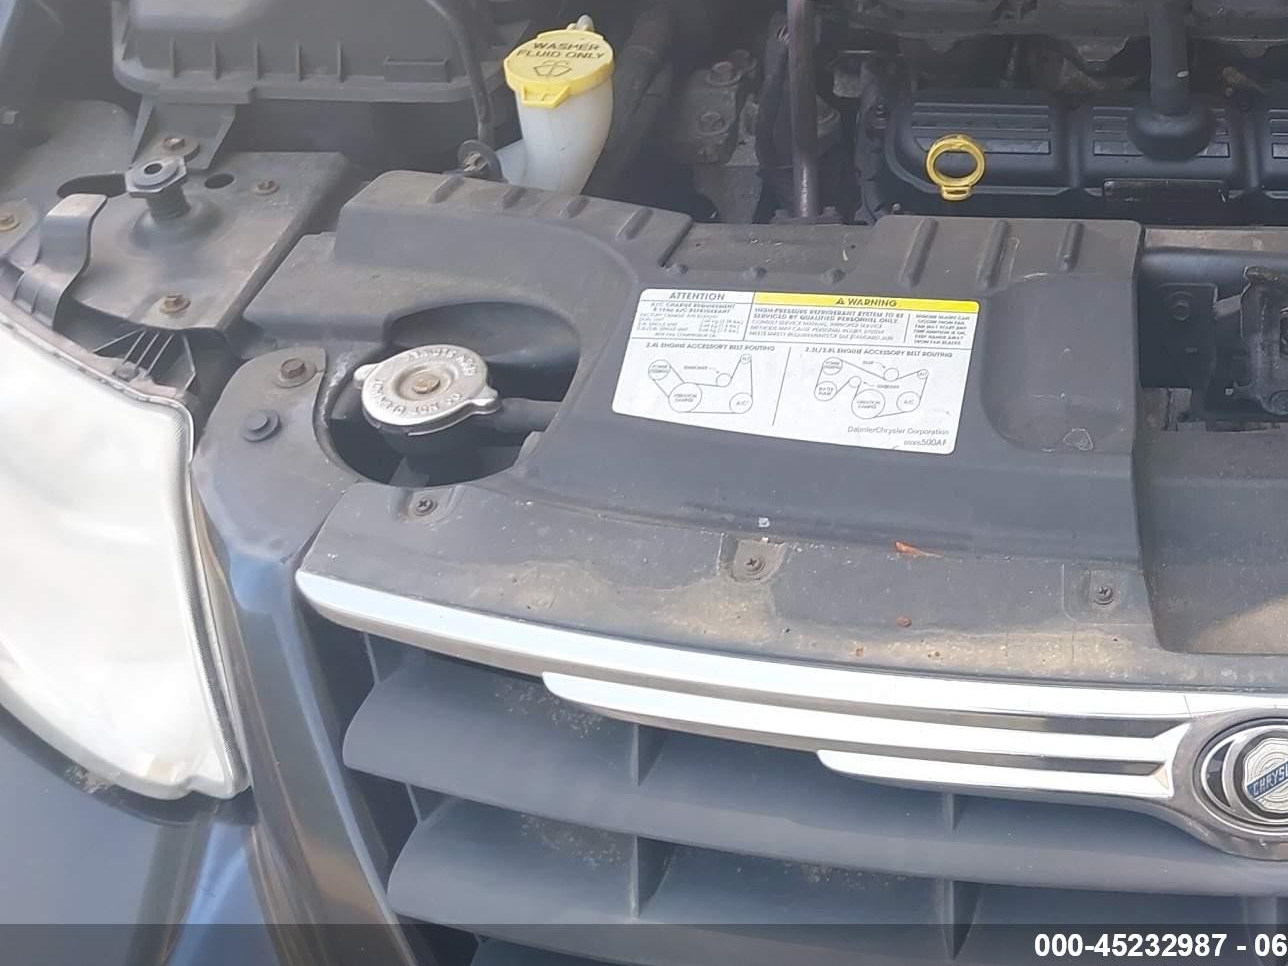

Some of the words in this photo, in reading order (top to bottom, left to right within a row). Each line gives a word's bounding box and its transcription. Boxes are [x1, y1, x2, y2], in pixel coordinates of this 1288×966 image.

[533, 42, 600, 50] WASHER
[516, 49, 560, 58] FLUID
[565, 51, 605, 59] ONLY
[669, 291, 726, 301] ATTENTION
[849, 298, 897, 308] WARNING
[848, 426, 906, 435] DaimlerChrysler
[907, 428, 950, 436] Corporation
